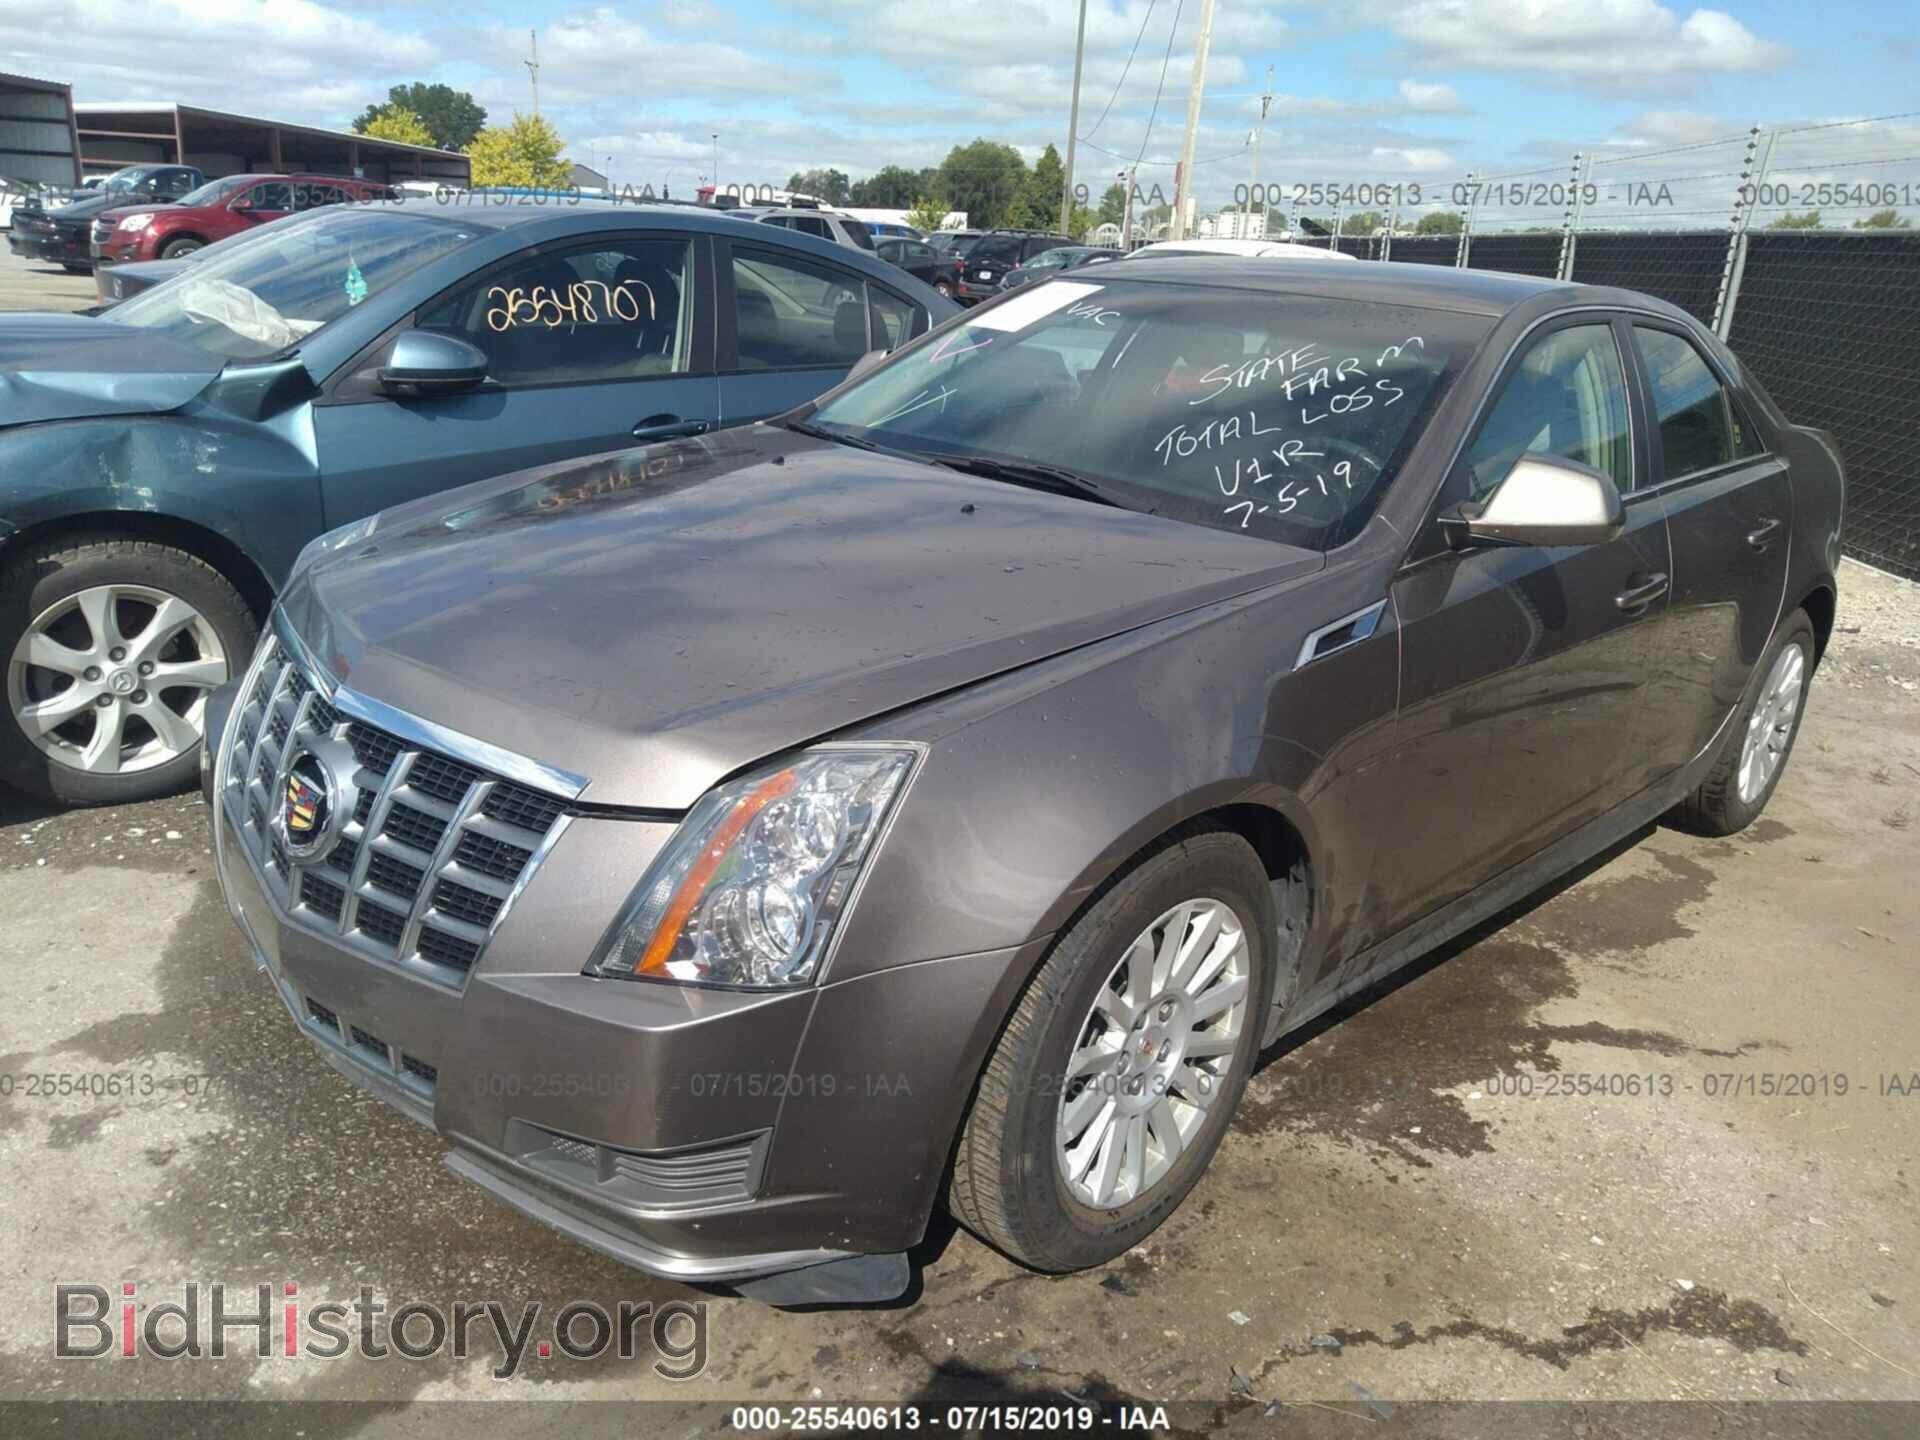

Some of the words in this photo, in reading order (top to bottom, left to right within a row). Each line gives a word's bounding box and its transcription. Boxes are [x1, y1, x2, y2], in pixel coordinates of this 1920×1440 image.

[487, 280, 656, 332] 25548707
[1189, 343, 1331, 405] STATE
[1155, 411, 1282, 466] TOTAL
[1302, 380, 1403, 424] LOSS
[1223, 460, 1353, 528] 7-5-19
